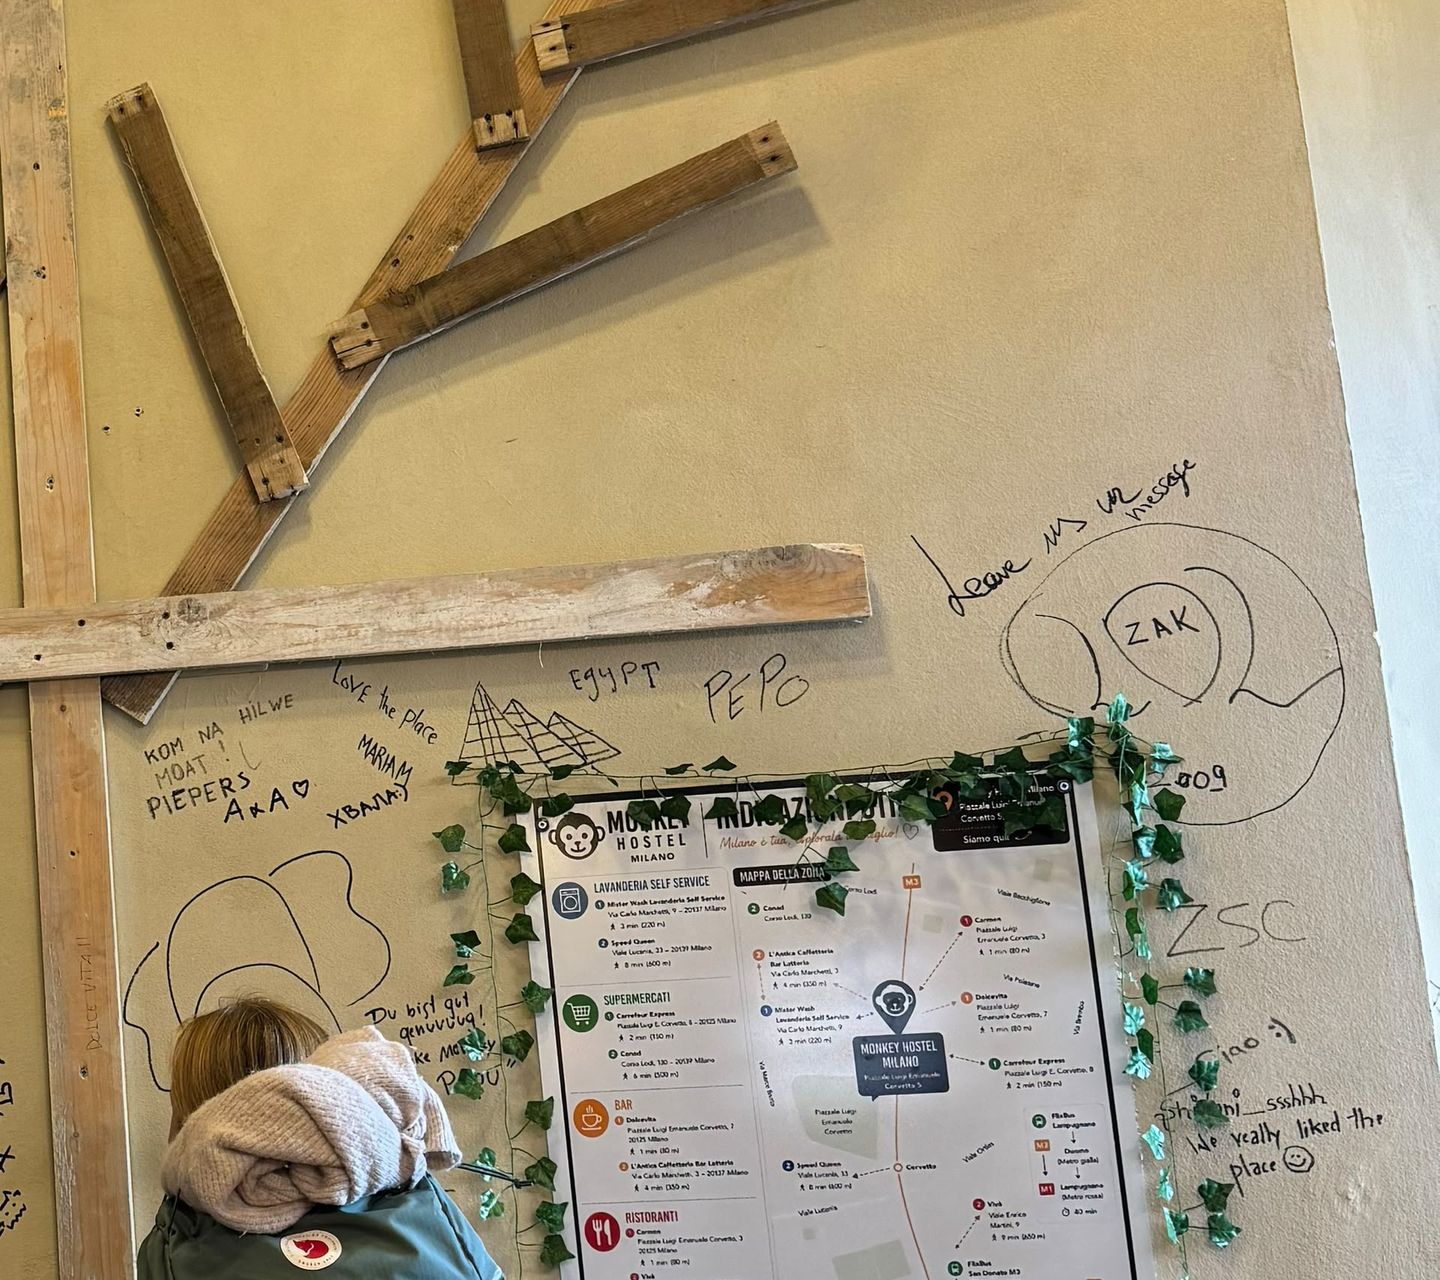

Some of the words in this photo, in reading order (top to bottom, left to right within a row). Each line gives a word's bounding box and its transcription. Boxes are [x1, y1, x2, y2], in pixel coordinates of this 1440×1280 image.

[1126, 605, 1201, 646] ZAK
[704, 653, 810, 723] PEPO
[198, 722, 224, 744] NA
[616, 833, 686, 850] HOSTEL
[962, 834, 991, 843] Siamo
[630, 852, 675, 862] MILANO
[739, 870, 771, 882] MAPPA
[772, 868, 800, 880] DELLA
[905, 877, 920, 887] M3
[593, 879, 649, 893] LAVANDERIA
[649, 878, 671, 889] SELF
[672, 875, 710, 888] SERVICE
[603, 991, 670, 1005] SUPERMERCATI
[860, 1042, 900, 1054] MONKEY
[902, 1040, 937, 1052] HOSTEL
[882, 1055, 919, 1068] MILANO
[1002, 1058, 1036, 1066] Carrefour
[1037, 1057, 1065, 1065] Express
[613, 1099, 633, 1110] BAR
[624, 1210, 678, 1223] RISTORANTI
